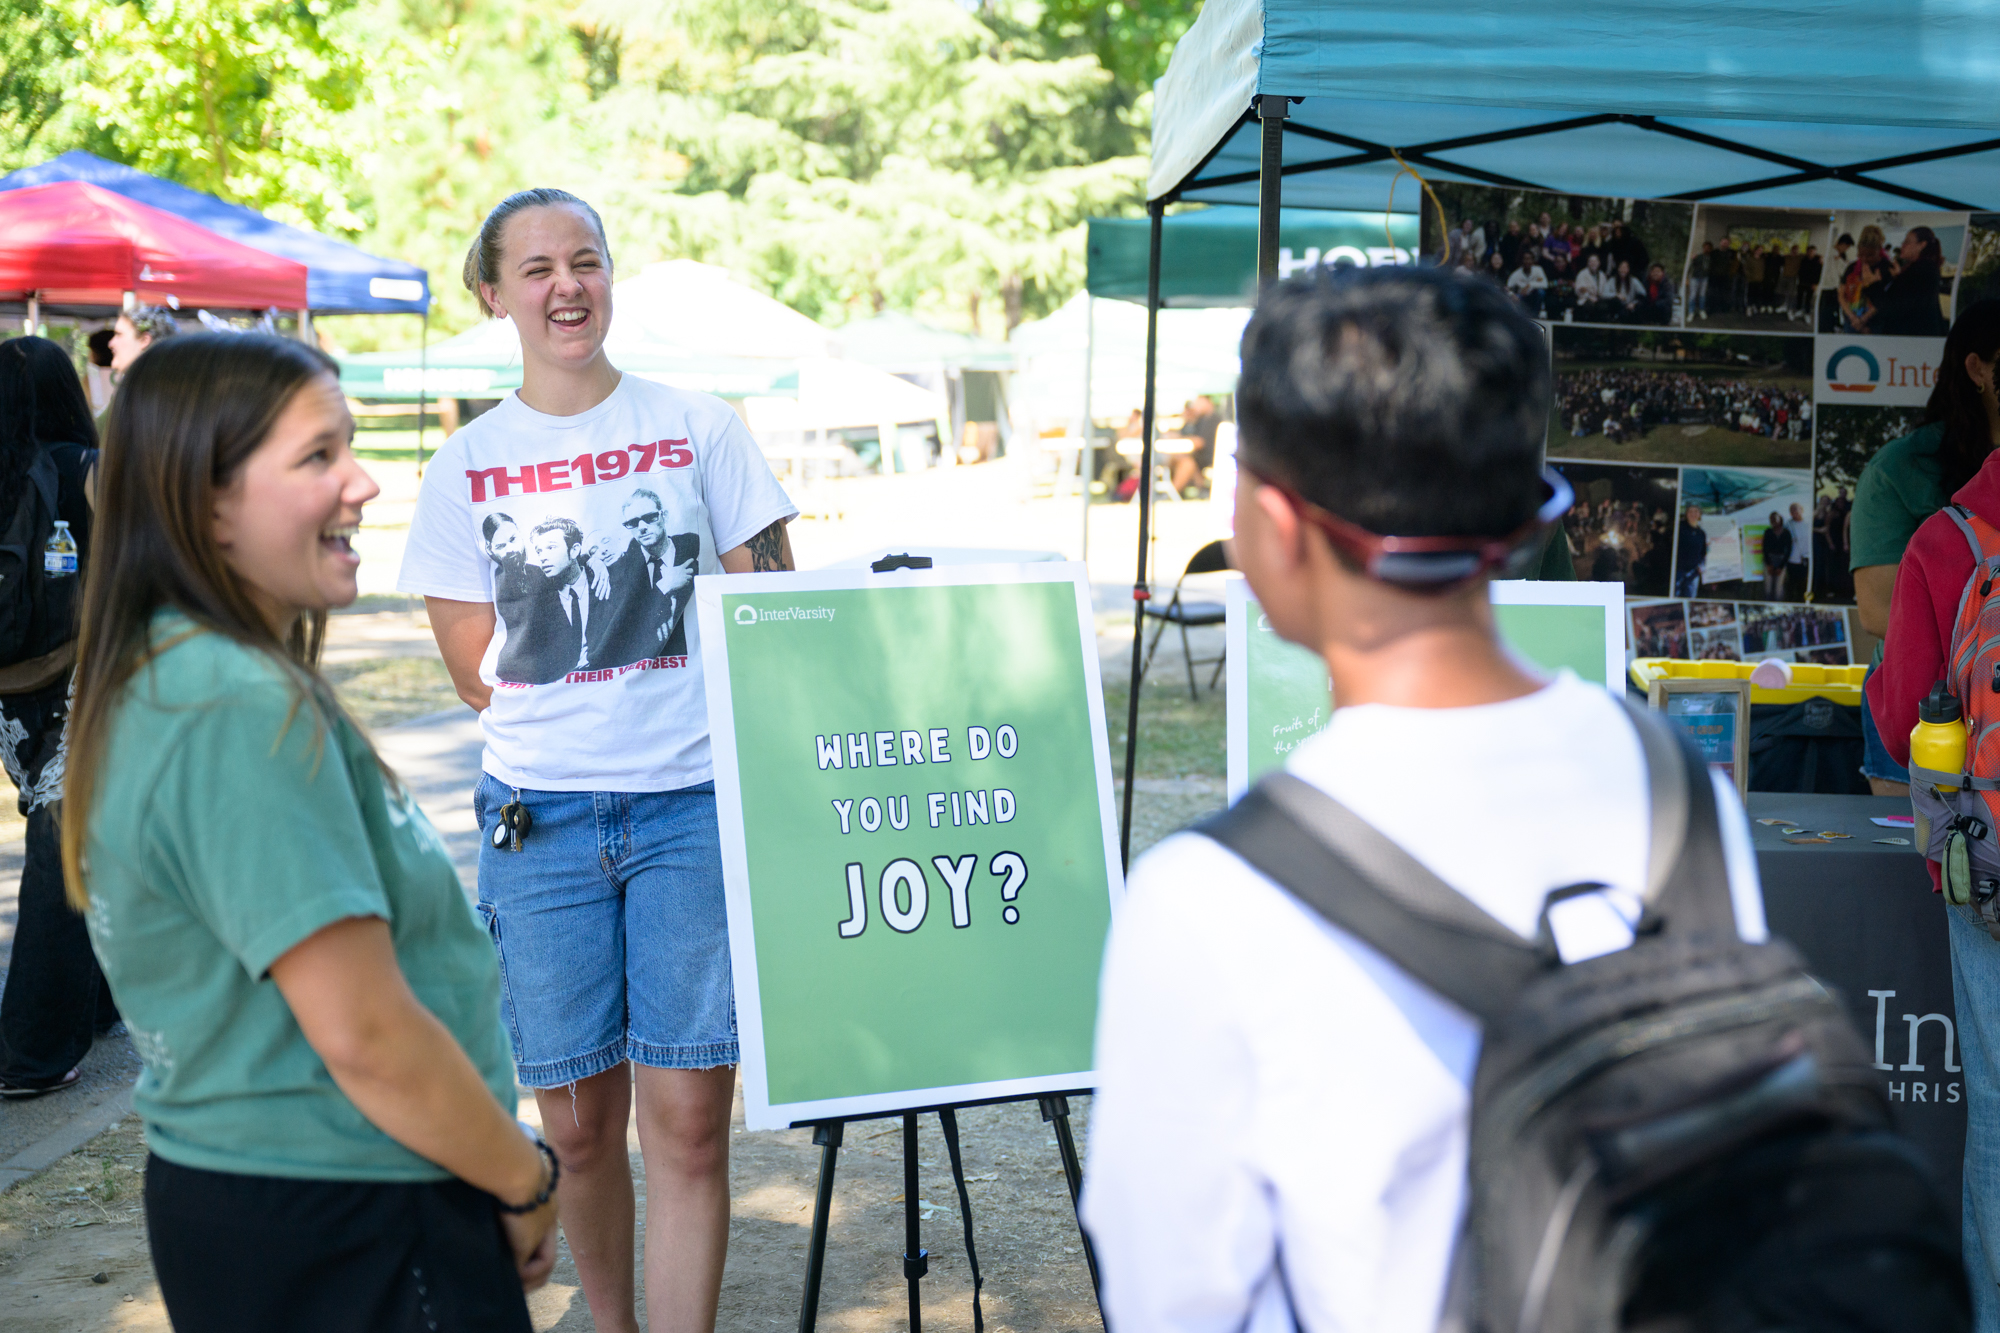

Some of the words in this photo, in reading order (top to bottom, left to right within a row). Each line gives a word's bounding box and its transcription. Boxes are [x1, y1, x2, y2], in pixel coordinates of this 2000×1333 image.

[759, 605, 836, 622] InterVarsity
[565, 668, 613, 684] THEIR
[652, 656, 688, 670] BEST
[1273, 716, 1303, 737] Fruits
[1307, 707, 1320, 727] of
[815, 728, 951, 770] WHERE
[967, 724, 1019, 761] DO
[1273, 740, 1293, 754] the
[831, 795, 910, 834] YOU
[927, 788, 1017, 828] FIND
[838, 850, 1028, 939] JOY?
[1888, 1081, 1961, 1103] HRIS
